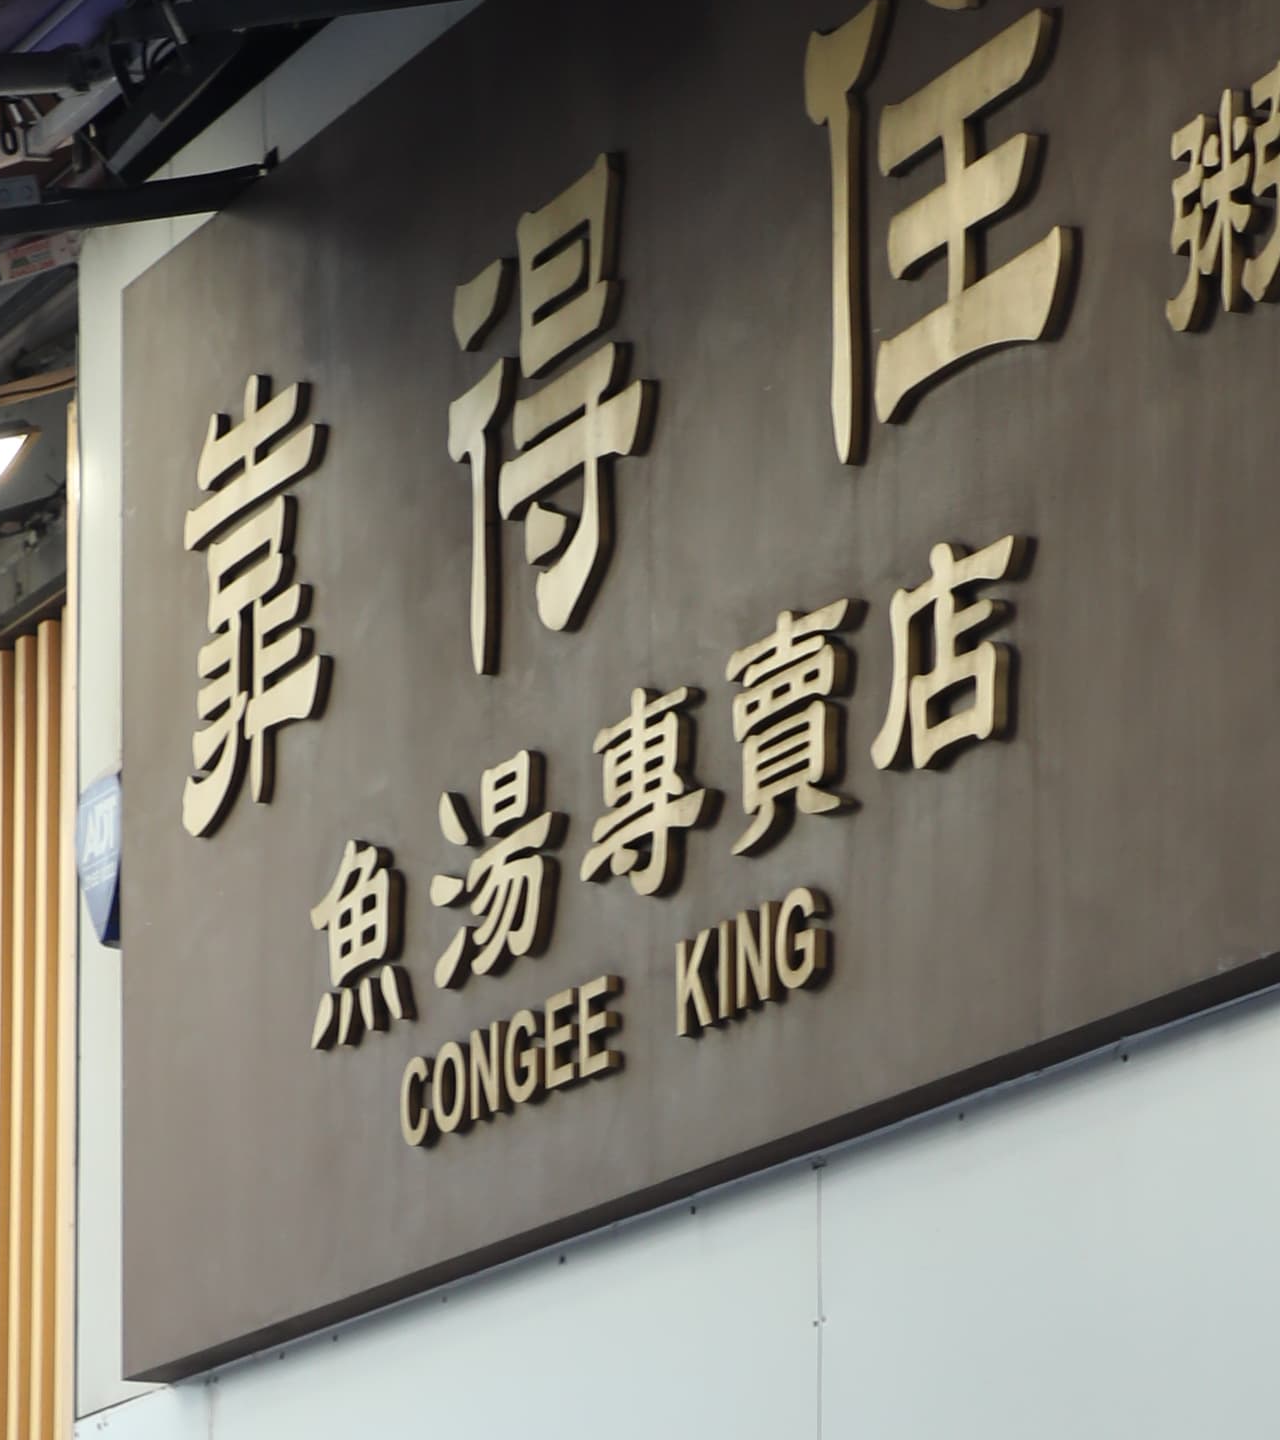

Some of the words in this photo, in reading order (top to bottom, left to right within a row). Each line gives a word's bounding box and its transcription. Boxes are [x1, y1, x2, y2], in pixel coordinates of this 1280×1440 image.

[311, 536, 1026, 1048] 魚湯專賣店
[400, 974, 622, 1148] CONGEE
[676, 887, 827, 1038] KING
